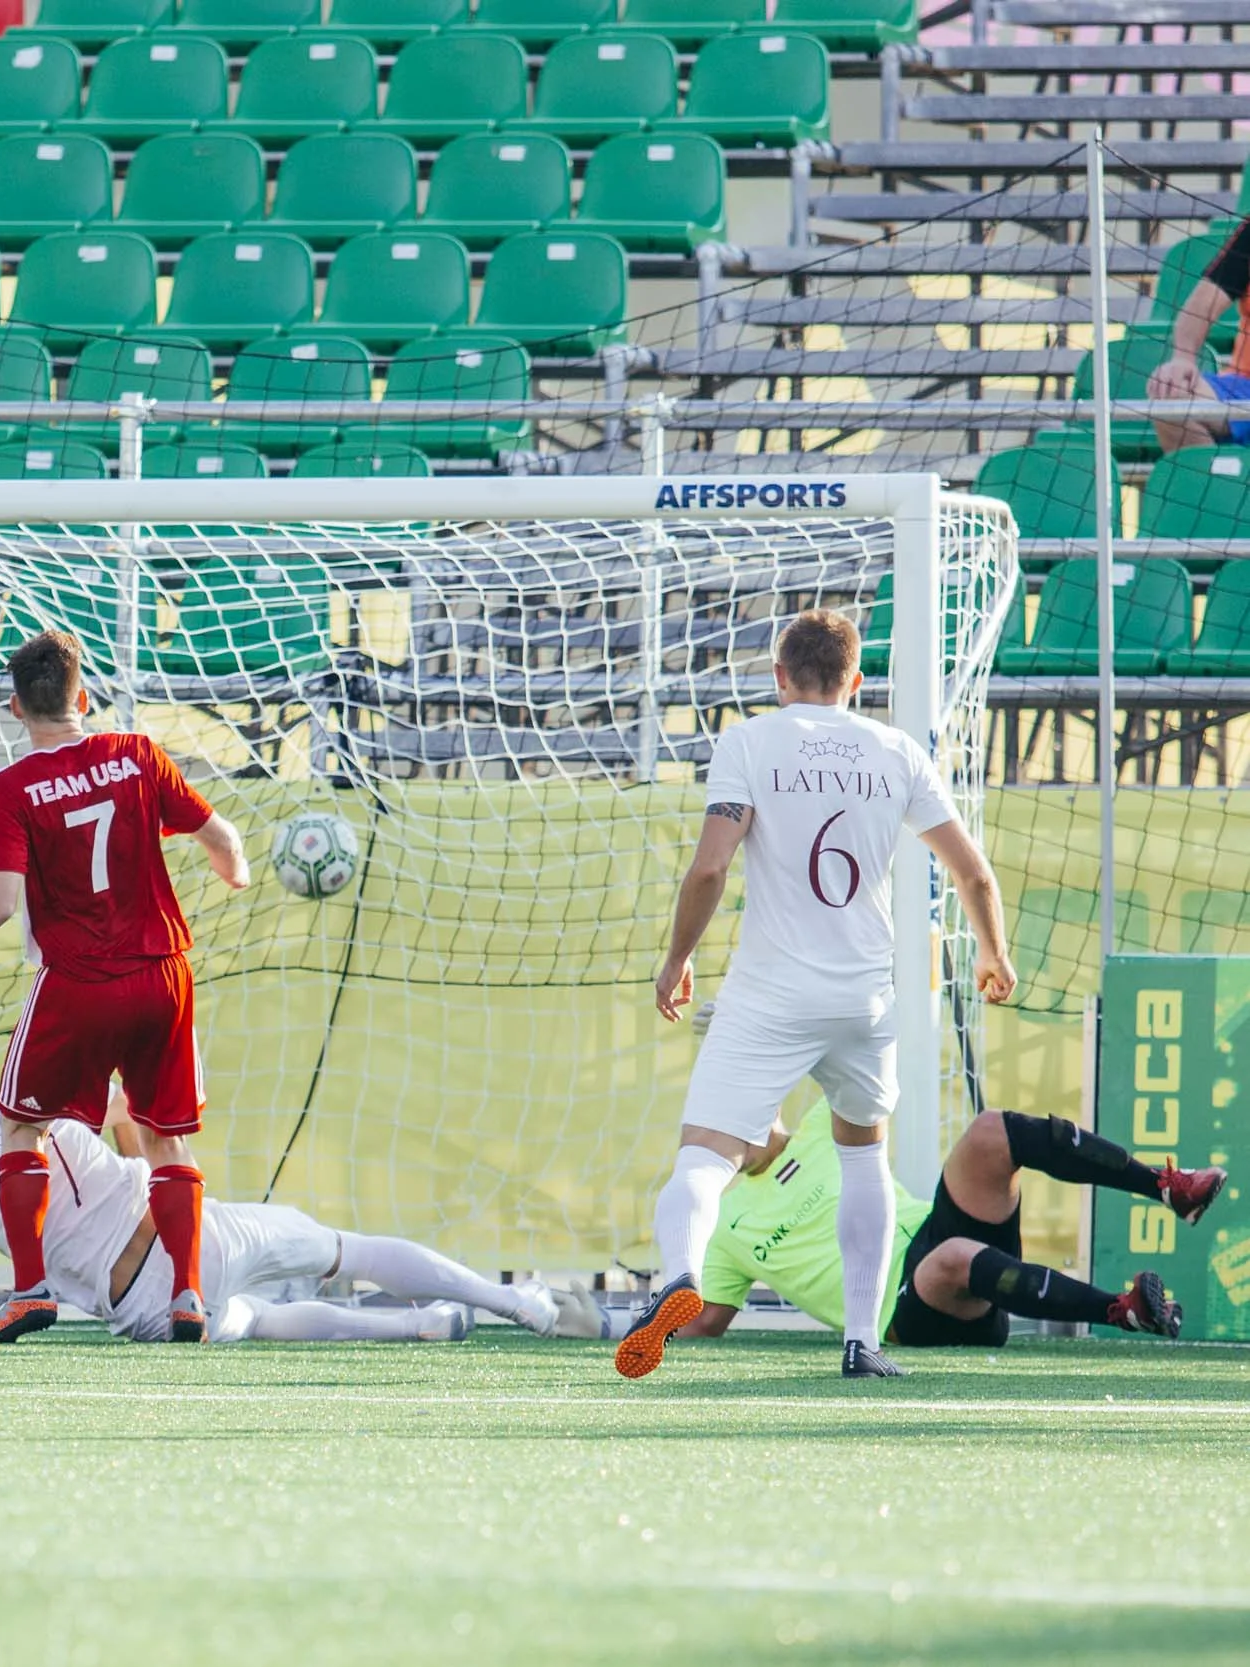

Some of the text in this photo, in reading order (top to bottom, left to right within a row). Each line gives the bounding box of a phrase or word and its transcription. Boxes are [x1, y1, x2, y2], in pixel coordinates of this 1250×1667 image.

[654, 483, 847, 509] AFFSPORTS
[24, 757, 142, 806] TEAM USA
[772, 768, 892, 802] LATVIJA
[64, 799, 116, 894] 7
[808, 809, 860, 908] 6
